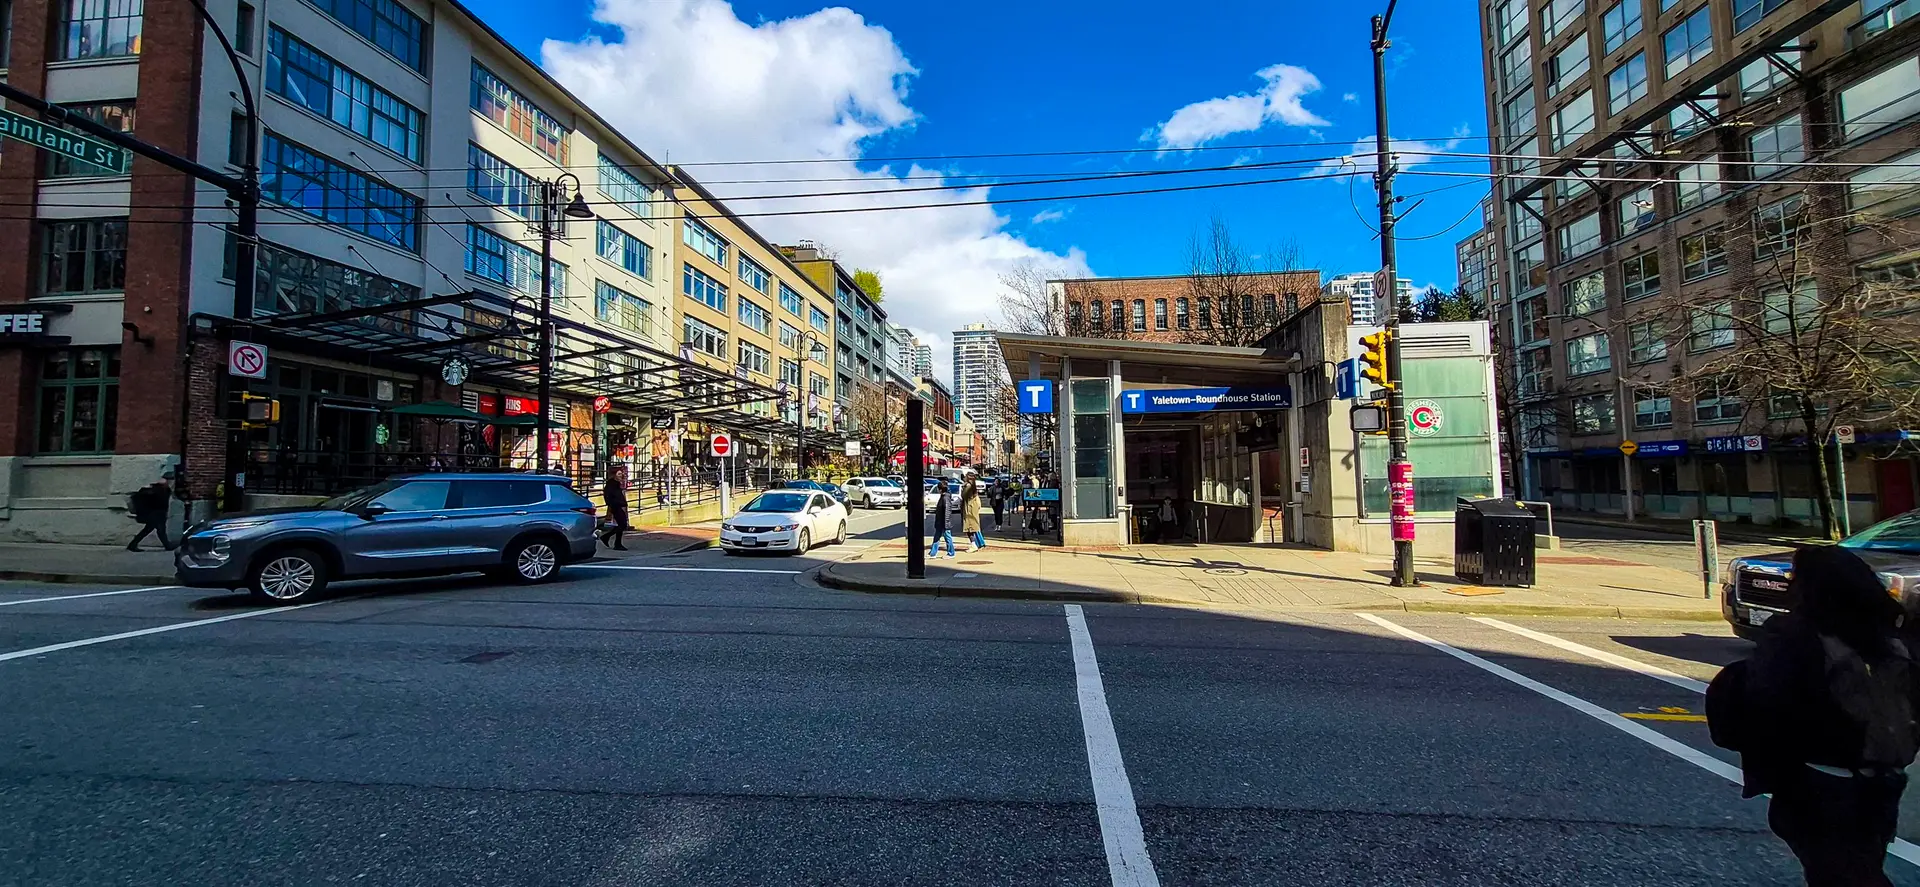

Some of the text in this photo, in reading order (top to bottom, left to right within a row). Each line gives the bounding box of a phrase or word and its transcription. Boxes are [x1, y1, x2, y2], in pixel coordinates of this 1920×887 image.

[95, 147, 113, 167] St
[0, 314, 43, 332] FEE
[1340, 366, 1349, 393] T
[1026, 385, 1045, 408] T
[1128, 393, 1140, 409] T
[1250, 392, 1281, 402] Station
[1752, 579, 1789, 591] GMC
